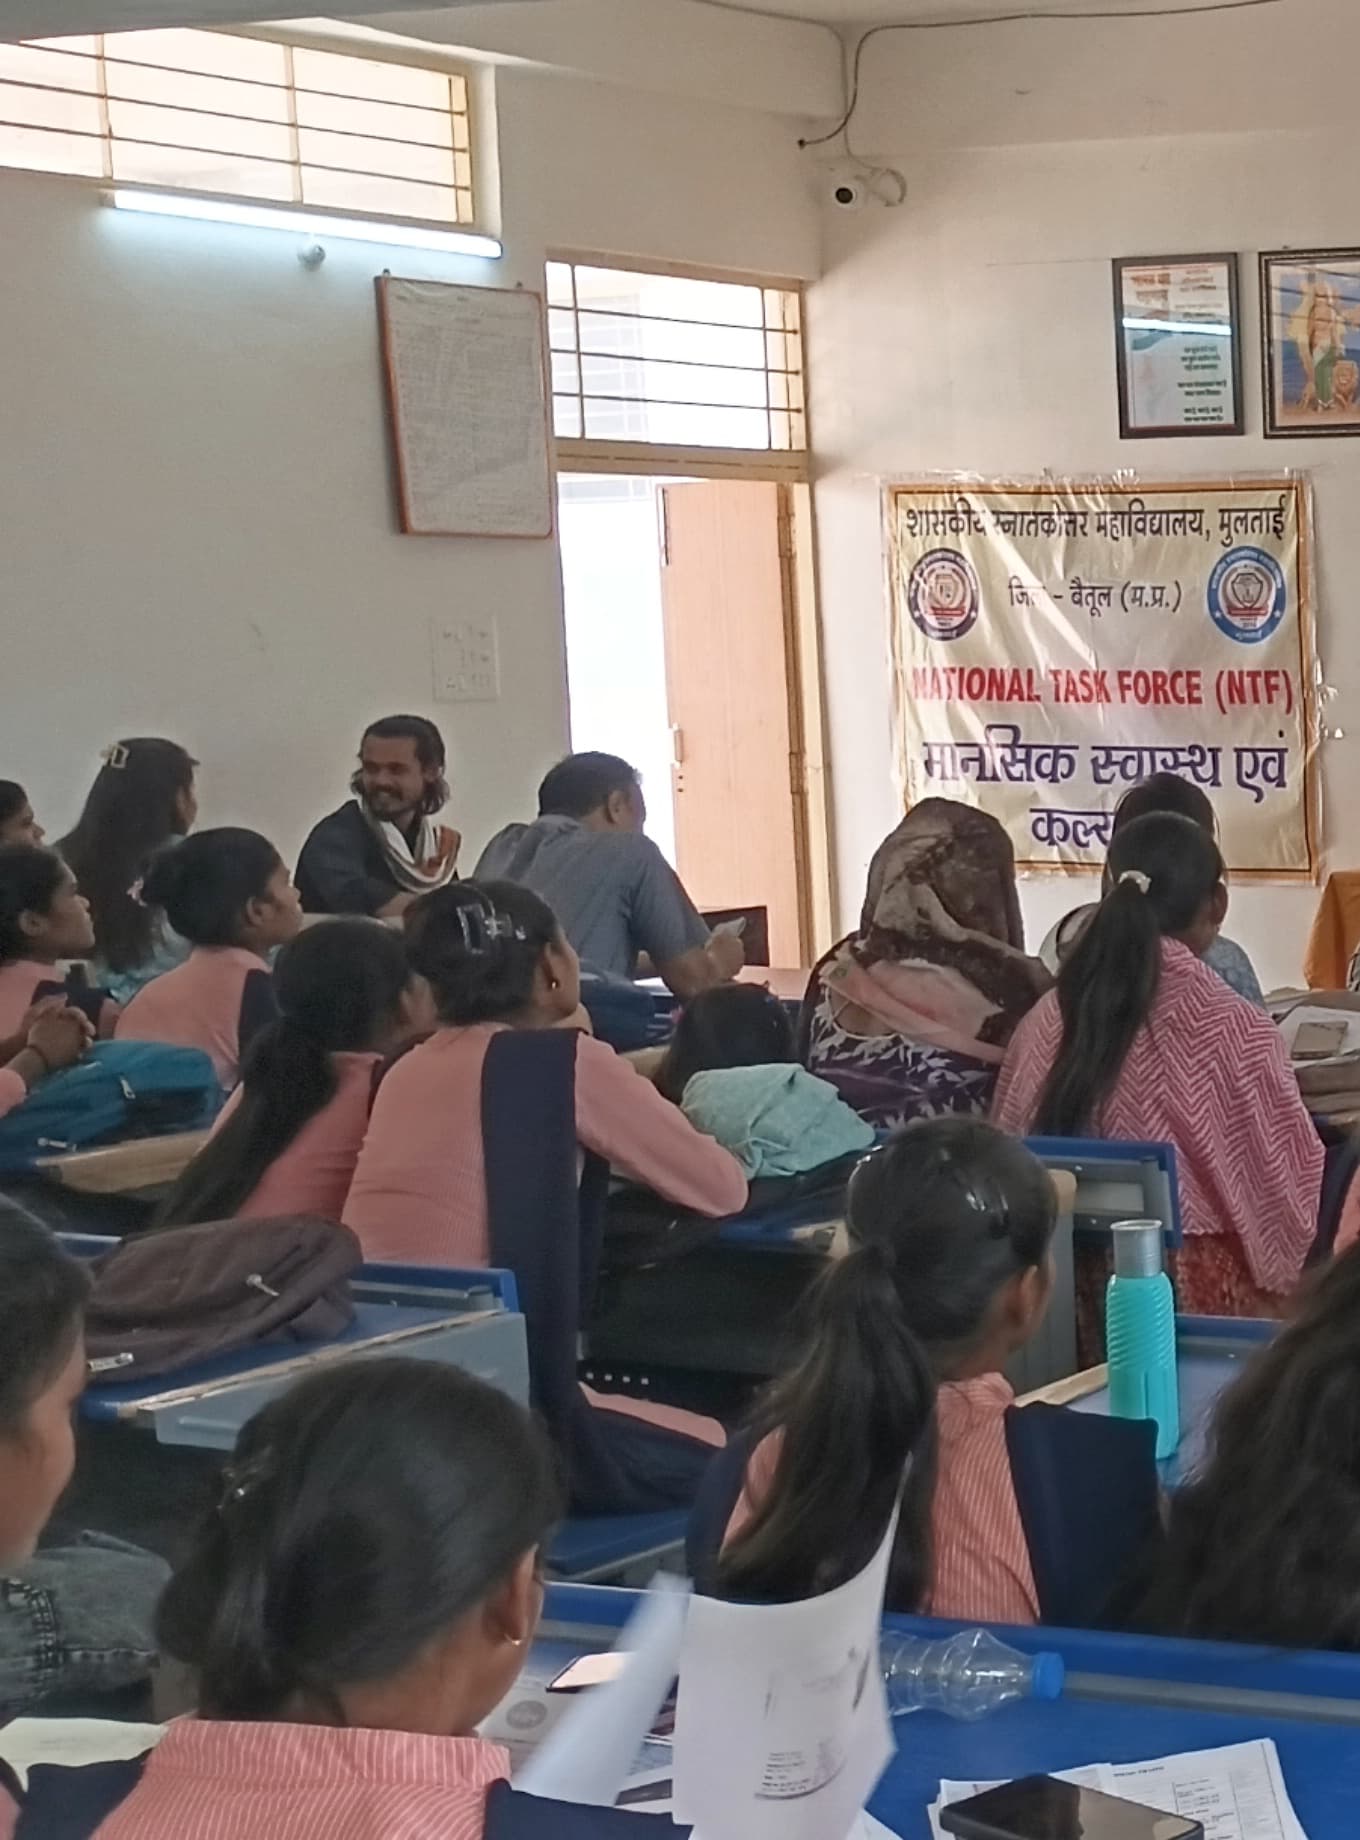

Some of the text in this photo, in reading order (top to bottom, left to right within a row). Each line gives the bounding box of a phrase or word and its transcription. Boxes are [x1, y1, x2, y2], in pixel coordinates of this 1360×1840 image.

[906, 494, 1286, 548] शासकीय स्नातकोत्तर महाविद्यालय, मुलताई
[1120, 580, 1182, 613] (म.प्र.)
[911, 667, 1293, 715] NATIONAL TASK FORCE (NTF)
[923, 723, 1080, 784] मानसिक
[1234, 729, 1290, 804] एवं
